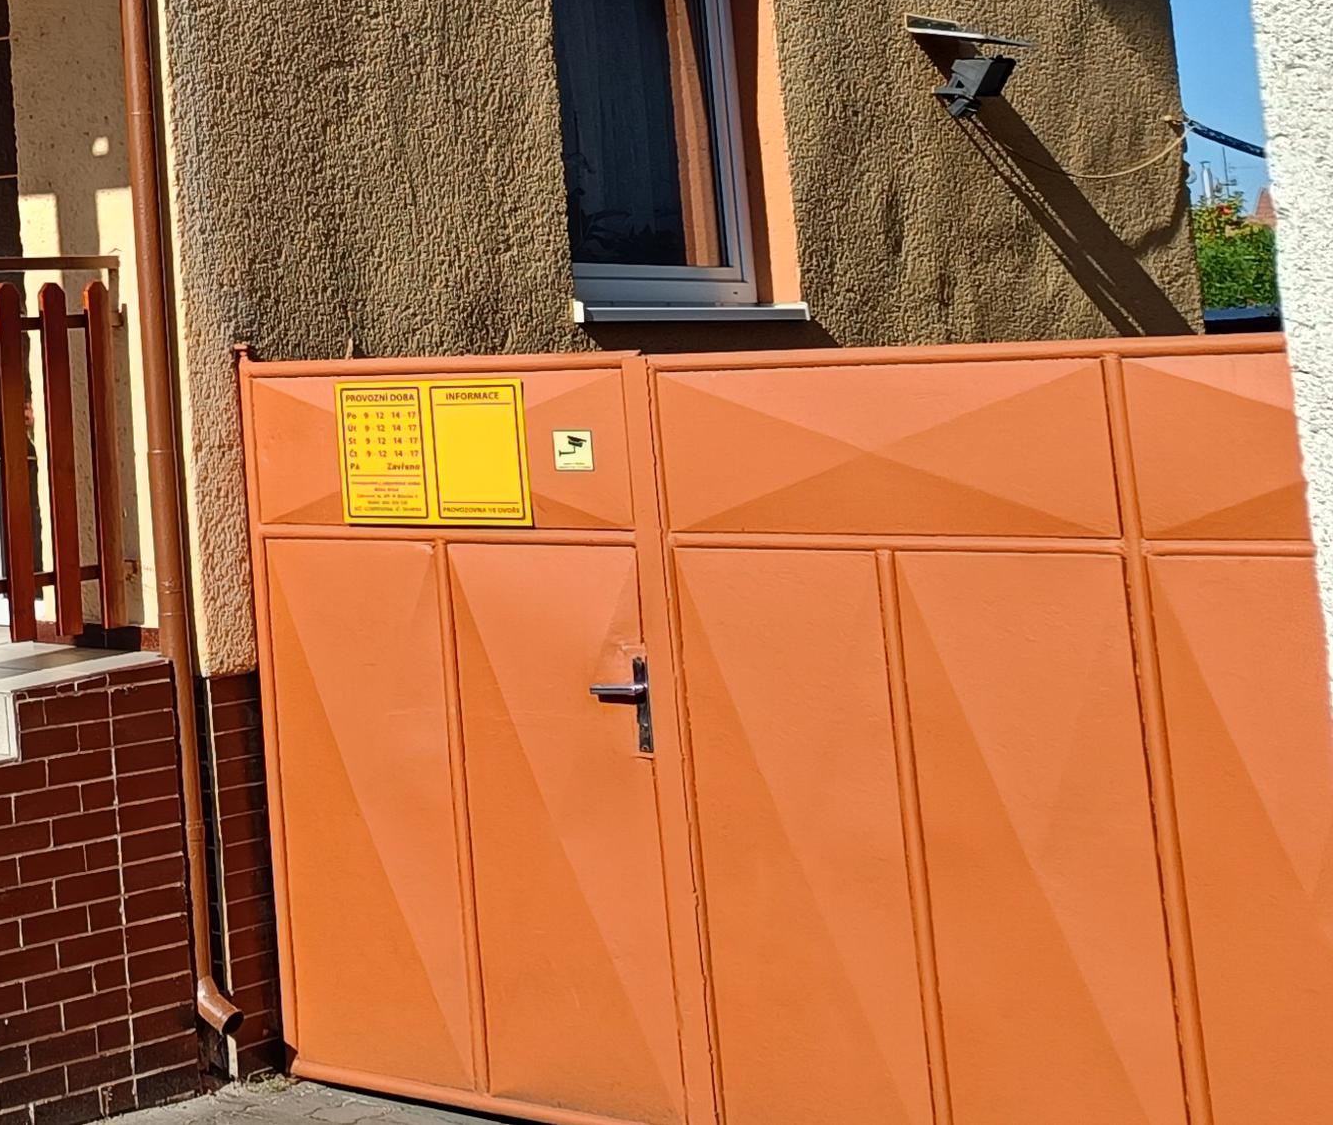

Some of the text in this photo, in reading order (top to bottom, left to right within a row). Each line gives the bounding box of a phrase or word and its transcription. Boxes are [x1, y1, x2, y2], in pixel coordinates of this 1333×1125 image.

[346, 393, 415, 402] PROVOZNÍ DOBA
[446, 391, 499, 400] INFORMACE
[365, 424, 370, 432] 9
[377, 424, 385, 432] 12
[393, 424, 401, 432] 14
[408, 424, 417, 432] 17
[366, 437, 370, 445] 9
[378, 437, 386, 445] 12
[394, 437, 402, 445] 14
[410, 437, 418, 445] 17
[387, 462, 420, 470] Zavřeno
